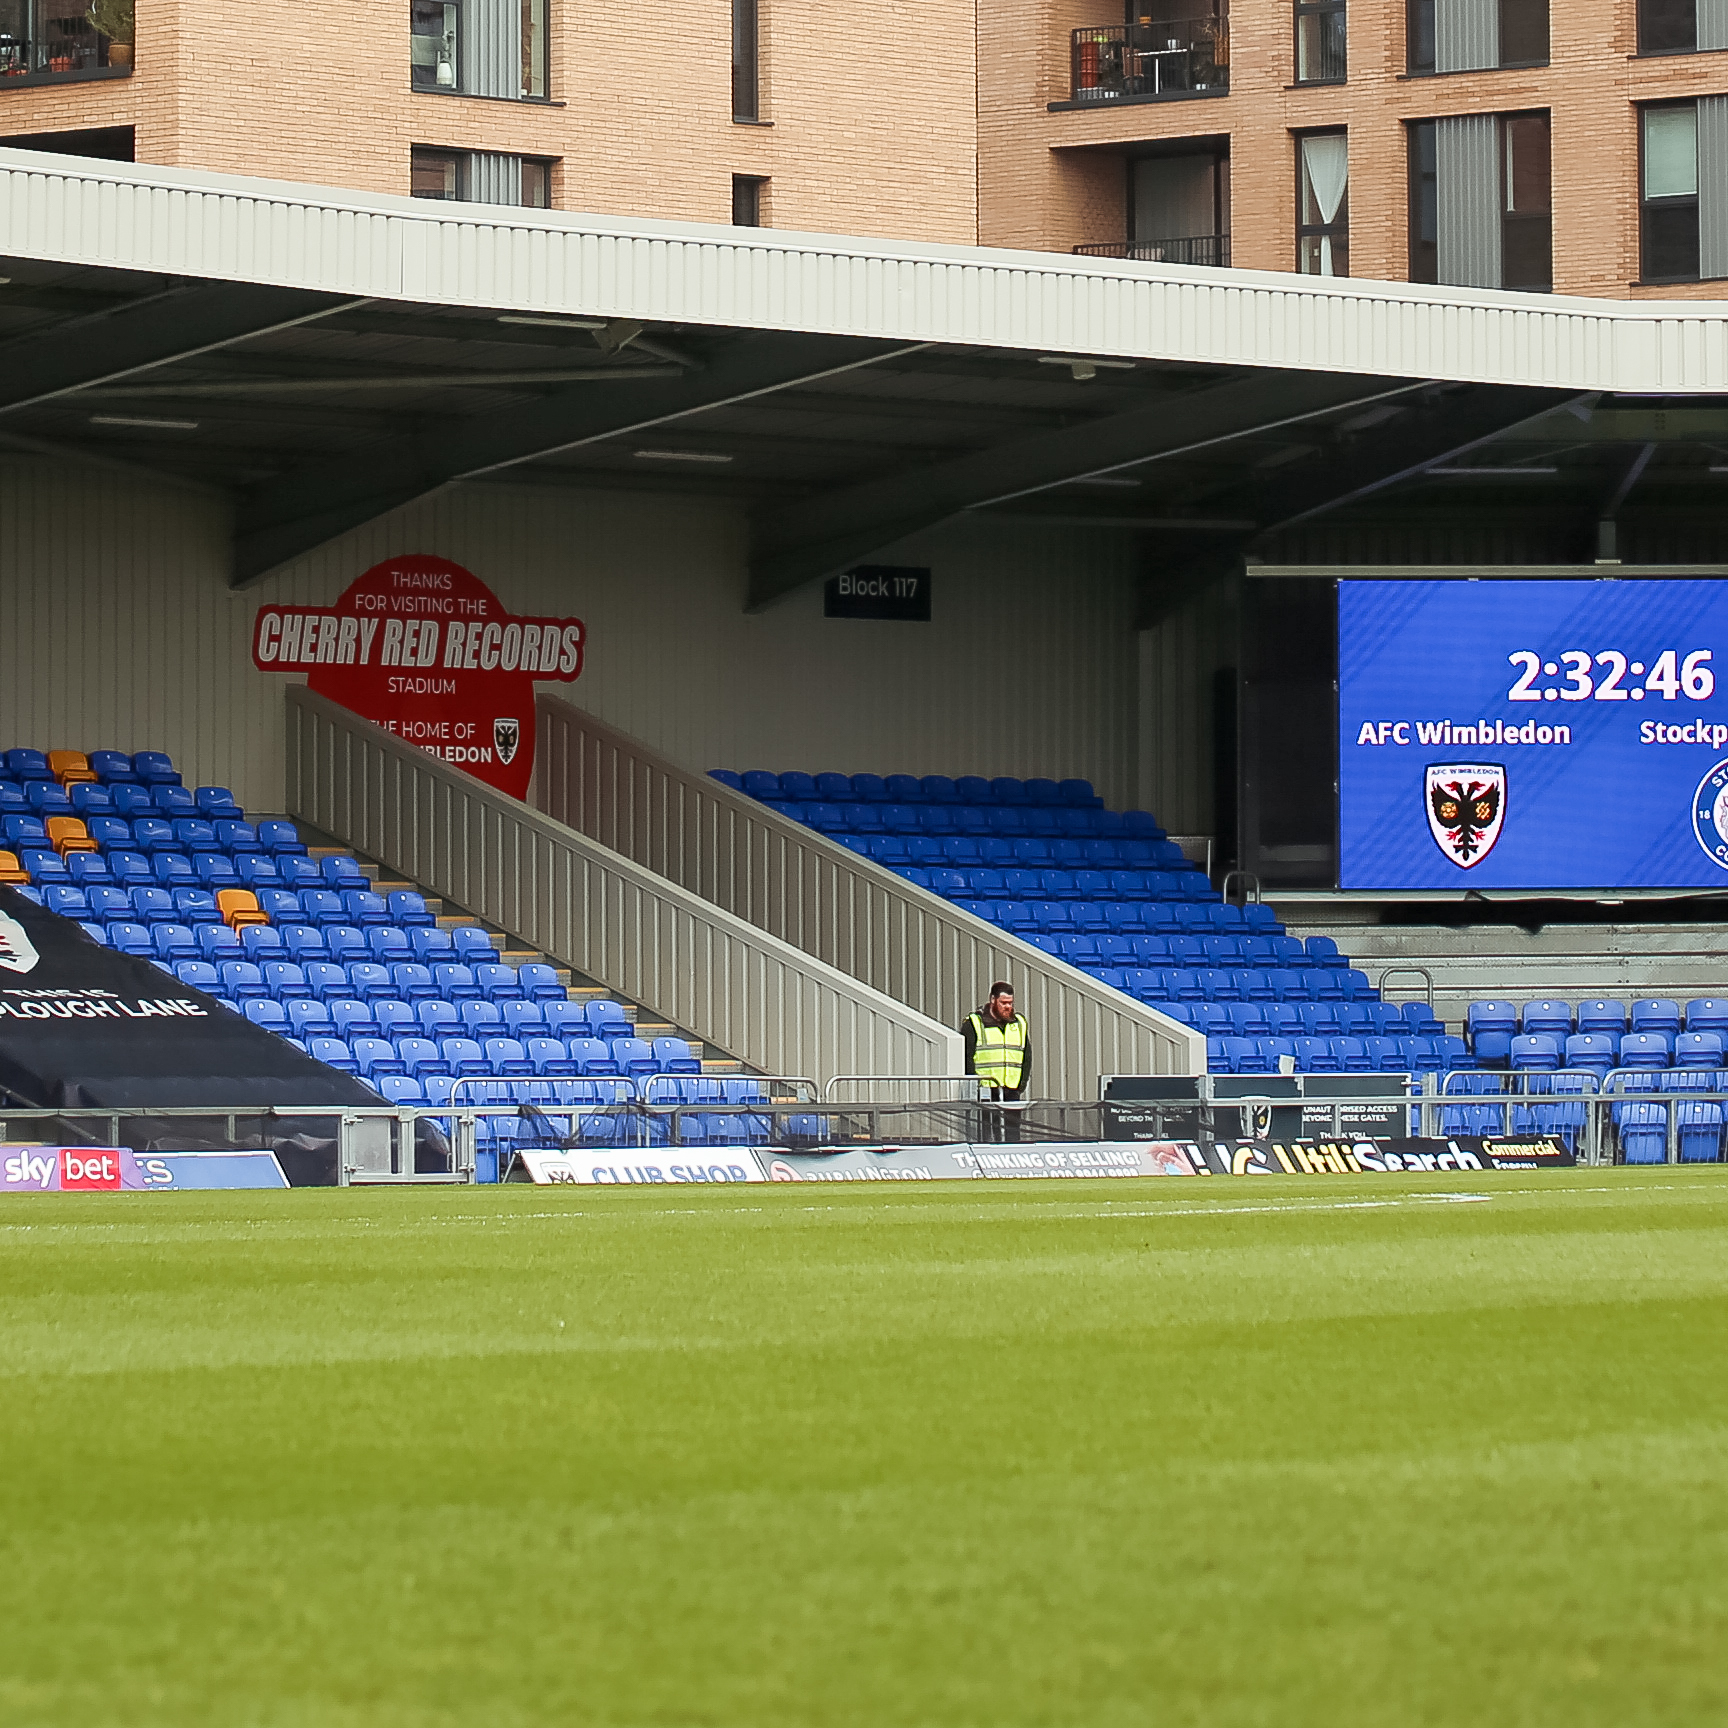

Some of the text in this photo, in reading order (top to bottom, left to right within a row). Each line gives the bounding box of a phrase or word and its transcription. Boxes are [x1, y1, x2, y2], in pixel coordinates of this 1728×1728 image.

[391, 571, 453, 590] THANKS
[838, 574, 918, 598] Block 117
[355, 594, 488, 616] FOR VISITING THE
[257, 612, 581, 673] CHERRY RED RECORDS
[388, 676, 457, 694] STADIUM
[1507, 649, 1715, 702] 2:32:46
[402, 721, 451, 739] HOME
[455, 722, 477, 740] OF
[1357, 720, 1572, 745] AFC Wimbledon
[418, 745, 492, 763] BLEDON
[1450, 768, 1501, 776] WIMBLEDON
[1699, 809, 1711, 820] 18
[115, 999, 209, 1017] LANE
[1367, 1105, 1398, 1113] ACCESS
[1482, 1139, 1561, 1157] Commercial
[4, 1149, 115, 1189] sky bet
[951, 1151, 1044, 1169] THINKING
[1044, 1152, 1069, 1168] OF
[592, 1164, 748, 1183] CLUB SHOP
